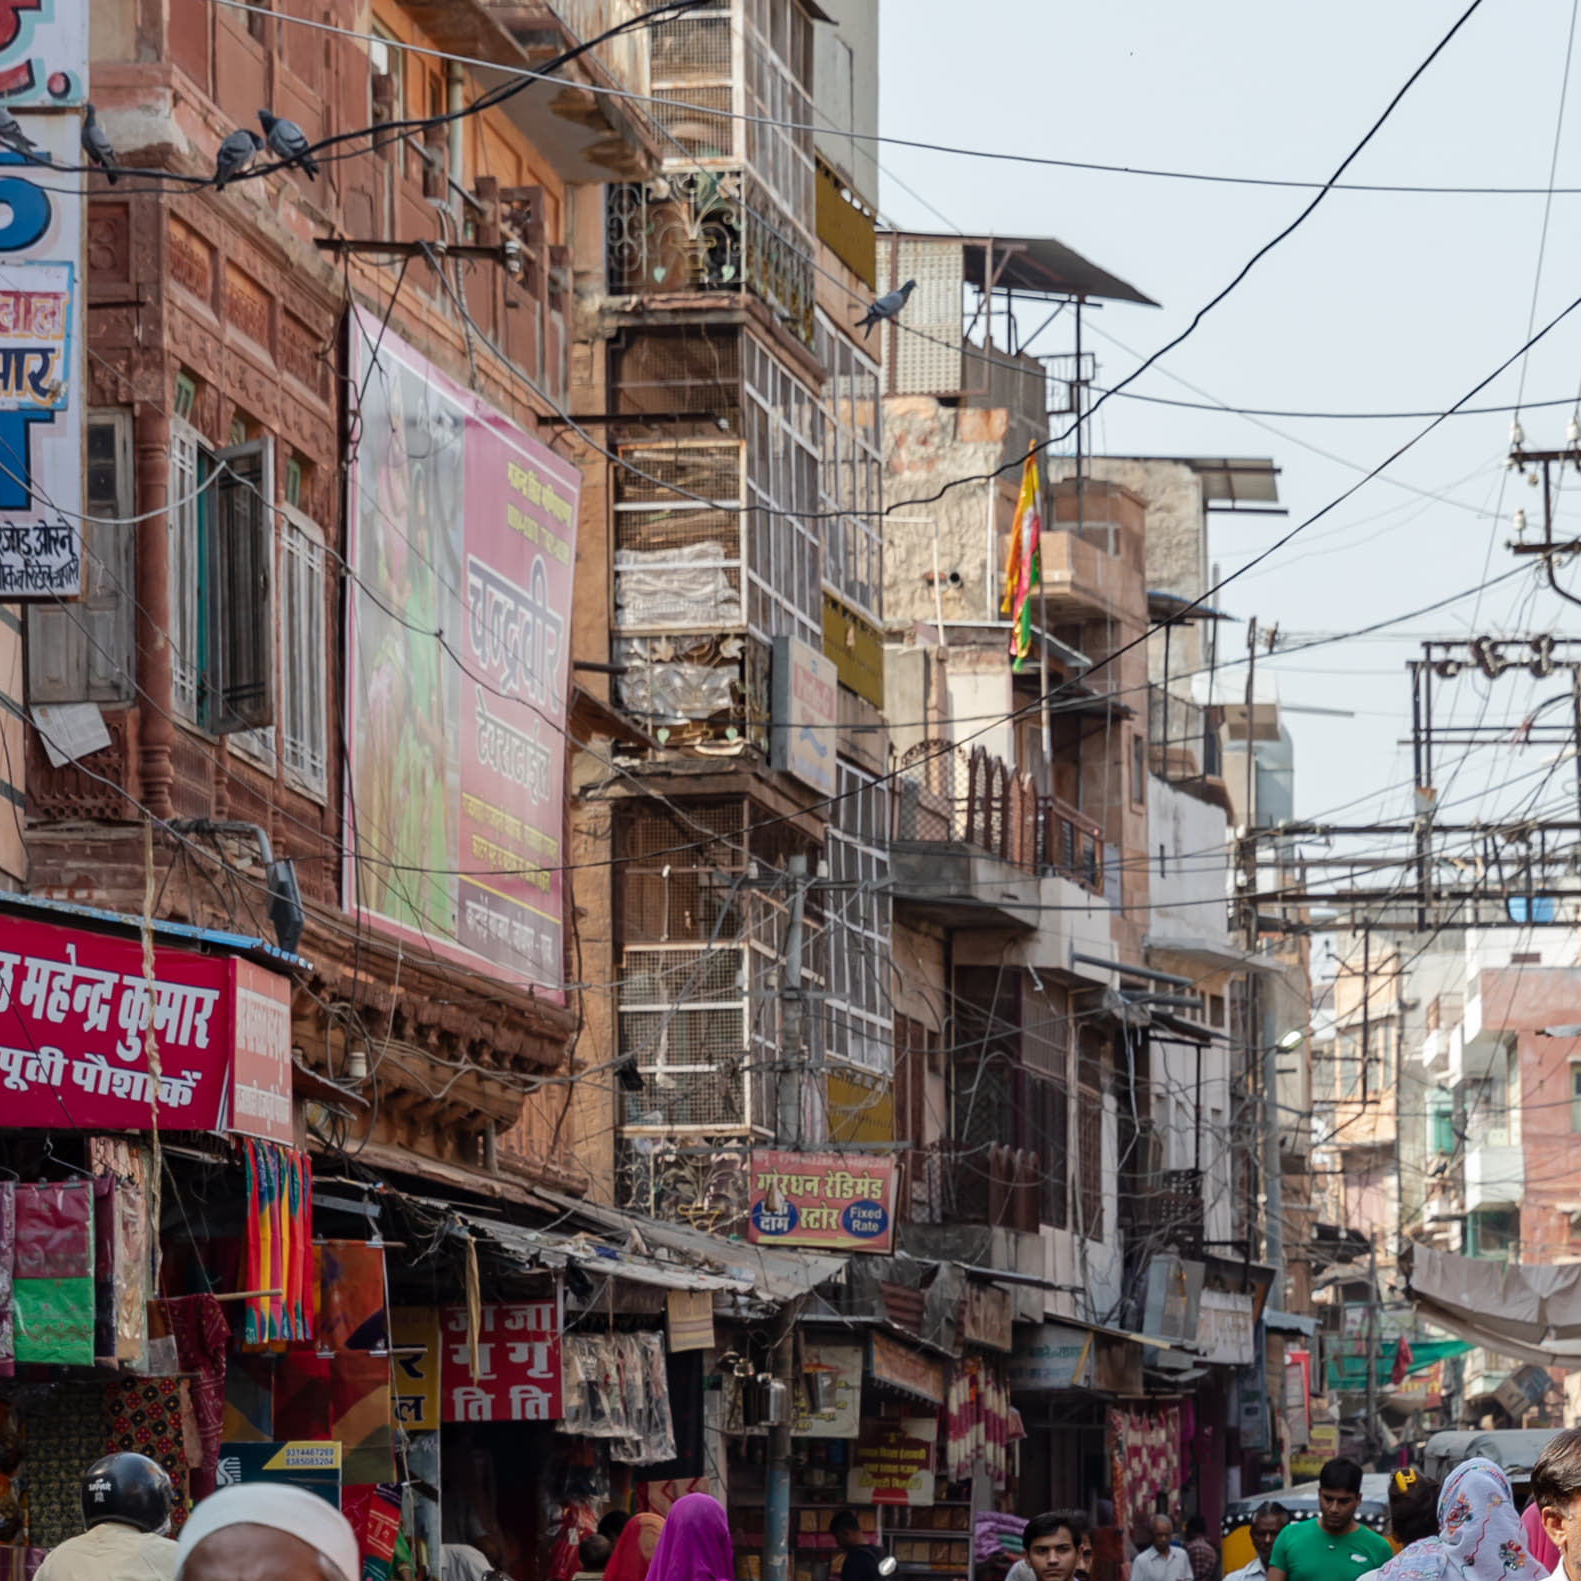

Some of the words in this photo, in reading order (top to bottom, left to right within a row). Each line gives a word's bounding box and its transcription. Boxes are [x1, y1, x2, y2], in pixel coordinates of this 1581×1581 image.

[465, 553, 564, 712] चन्द्रवीर
[18, 942, 120, 1033] महेन्द्र
[116, 974, 220, 1062] कुमार
[71, 1053, 203, 1109] पौशाकें
[759, 1216, 790, 1233] दाम
[799, 1200, 840, 1230] स्टोर
[849, 1206, 883, 1220] Fixed
[852, 1219, 879, 1233] Rate
